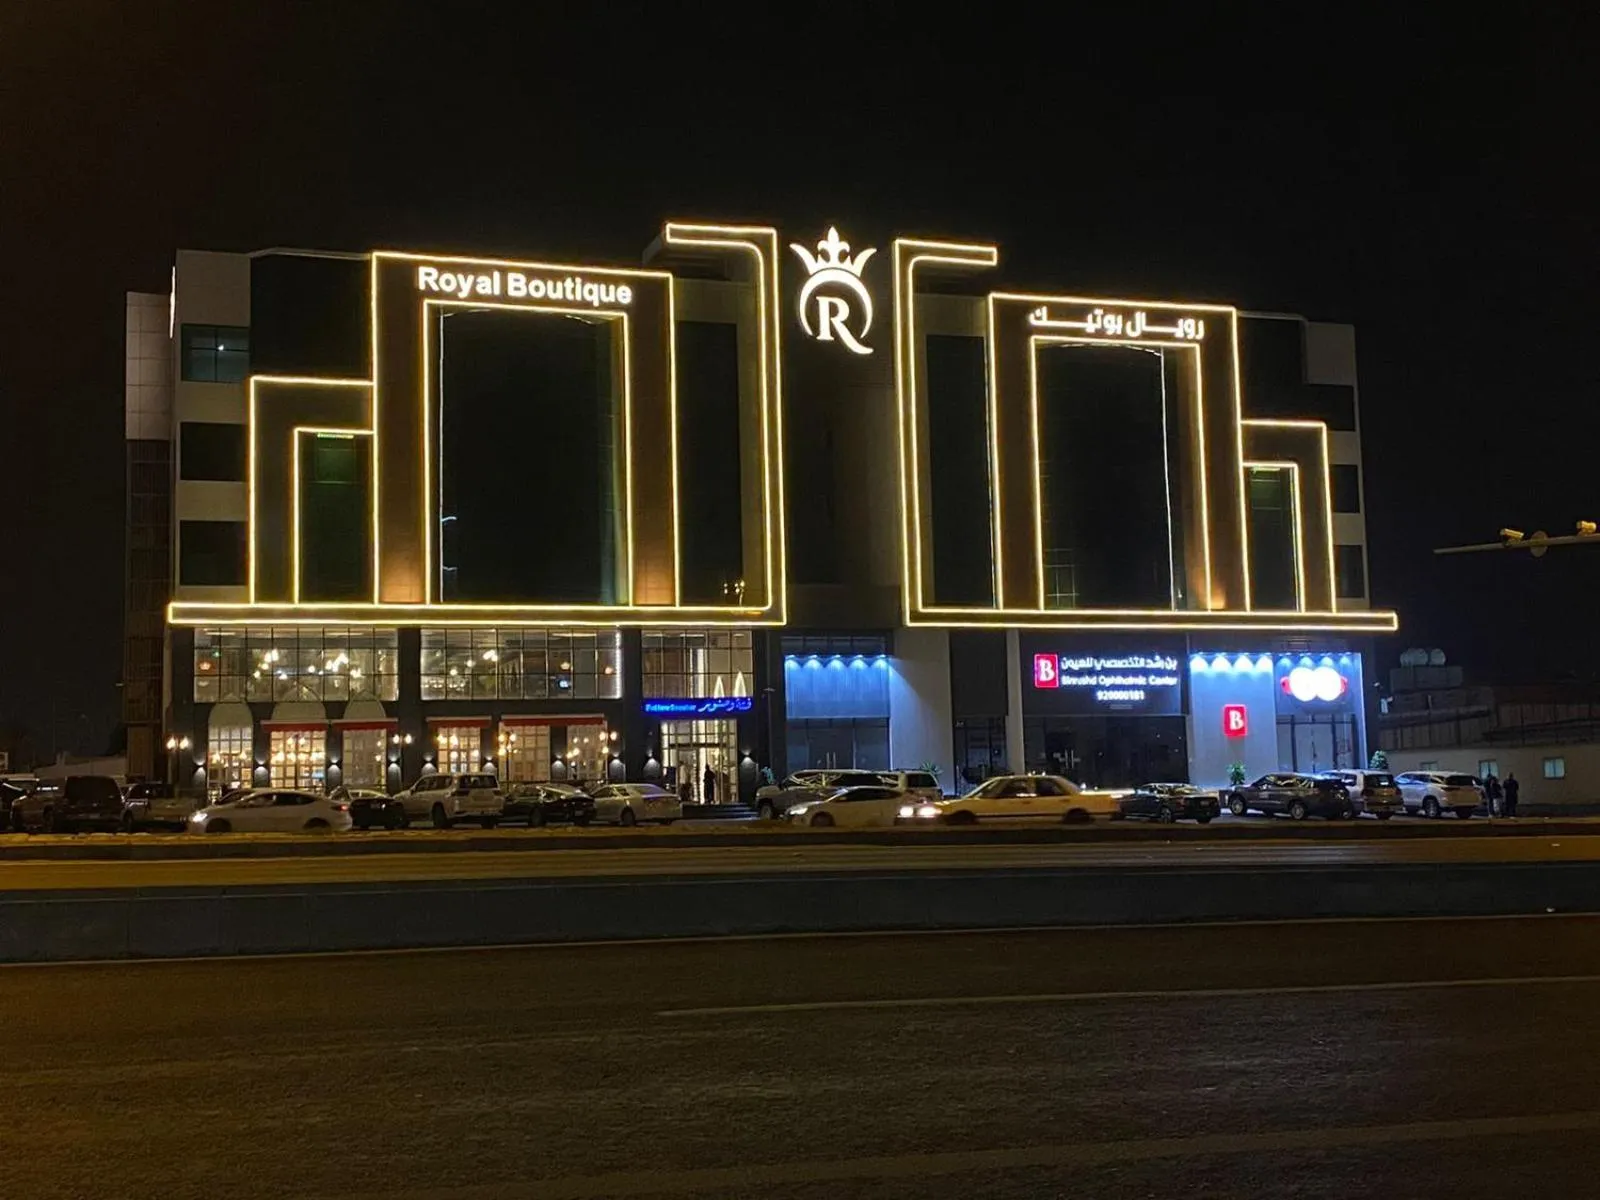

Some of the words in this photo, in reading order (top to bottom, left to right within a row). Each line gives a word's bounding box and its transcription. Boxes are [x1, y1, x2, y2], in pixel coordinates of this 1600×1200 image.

[418, 266, 501, 299] Royal
[507, 272, 632, 307] Boutique
[816, 296, 874, 354] R
[1028, 306, 1123, 335] بوتيك
[1126, 311, 1205, 339] رويال
[1039, 659, 1055, 681] B
[1145, 655, 1164, 669] رشد
[1148, 674, 1178, 685] Center
[1229, 710, 1244, 731] B
